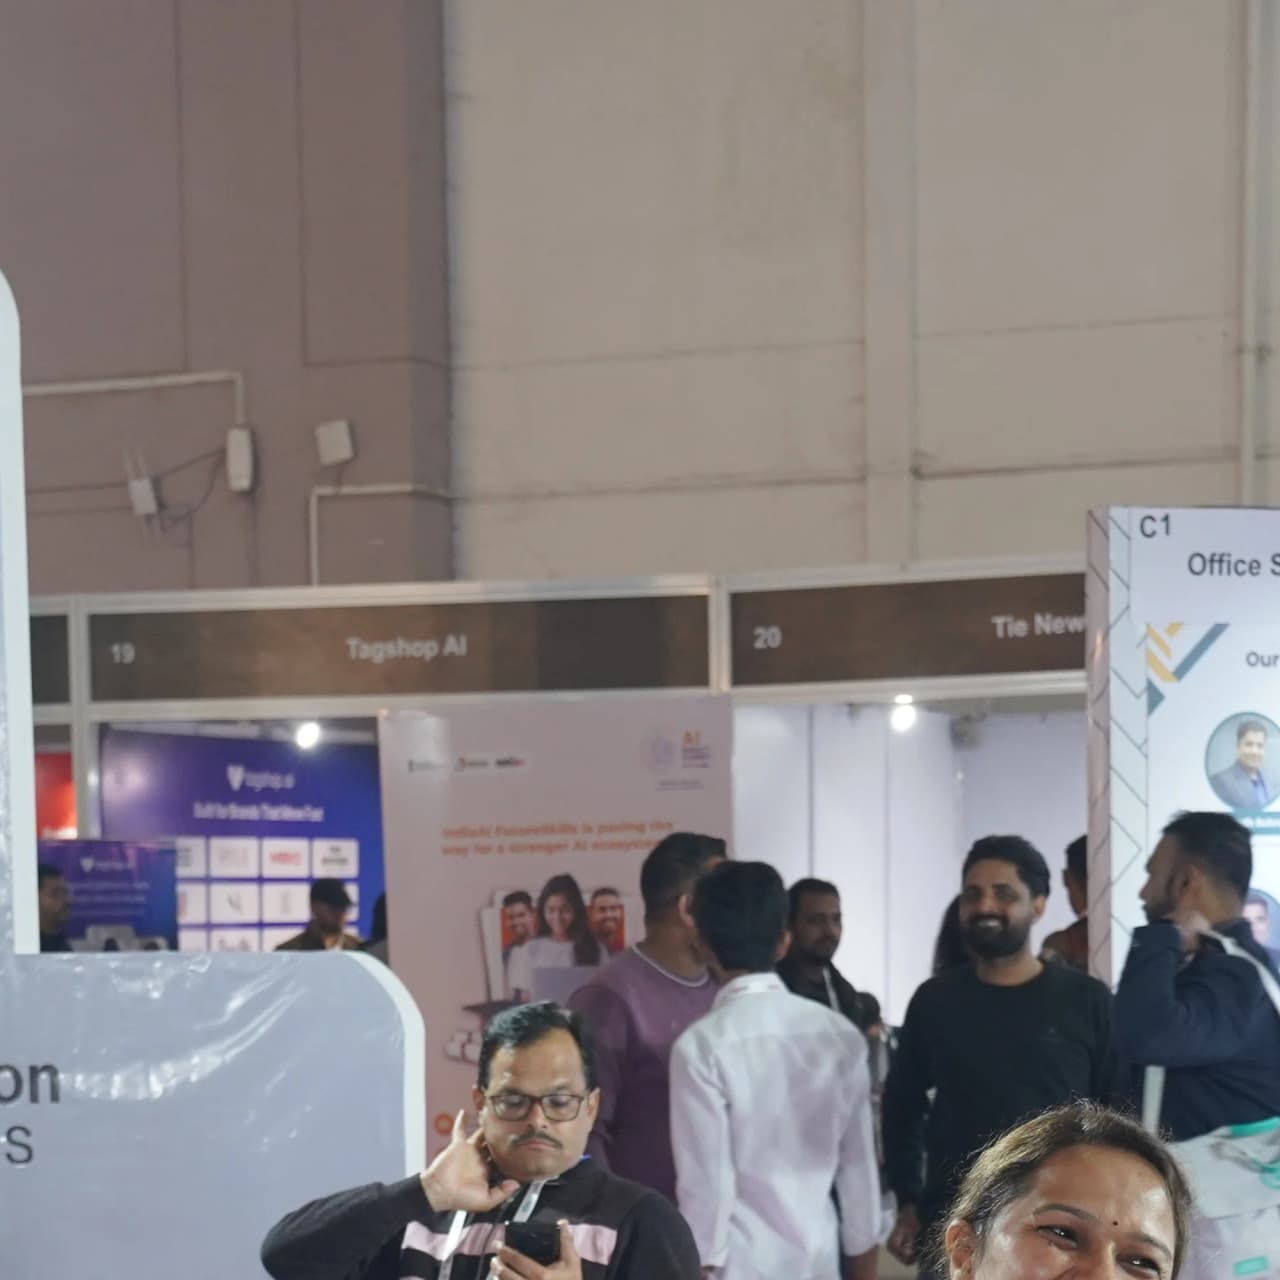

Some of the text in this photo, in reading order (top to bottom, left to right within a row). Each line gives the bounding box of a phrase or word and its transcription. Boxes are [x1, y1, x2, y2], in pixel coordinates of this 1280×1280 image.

[1138, 513, 1171, 539] C1
[1187, 552, 1262, 577] Office
[345, 634, 468, 663] Tagshop AI
[753, 625, 783, 649] 20
[111, 642, 136, 665] 19
[1245, 650, 1280, 669] Our
